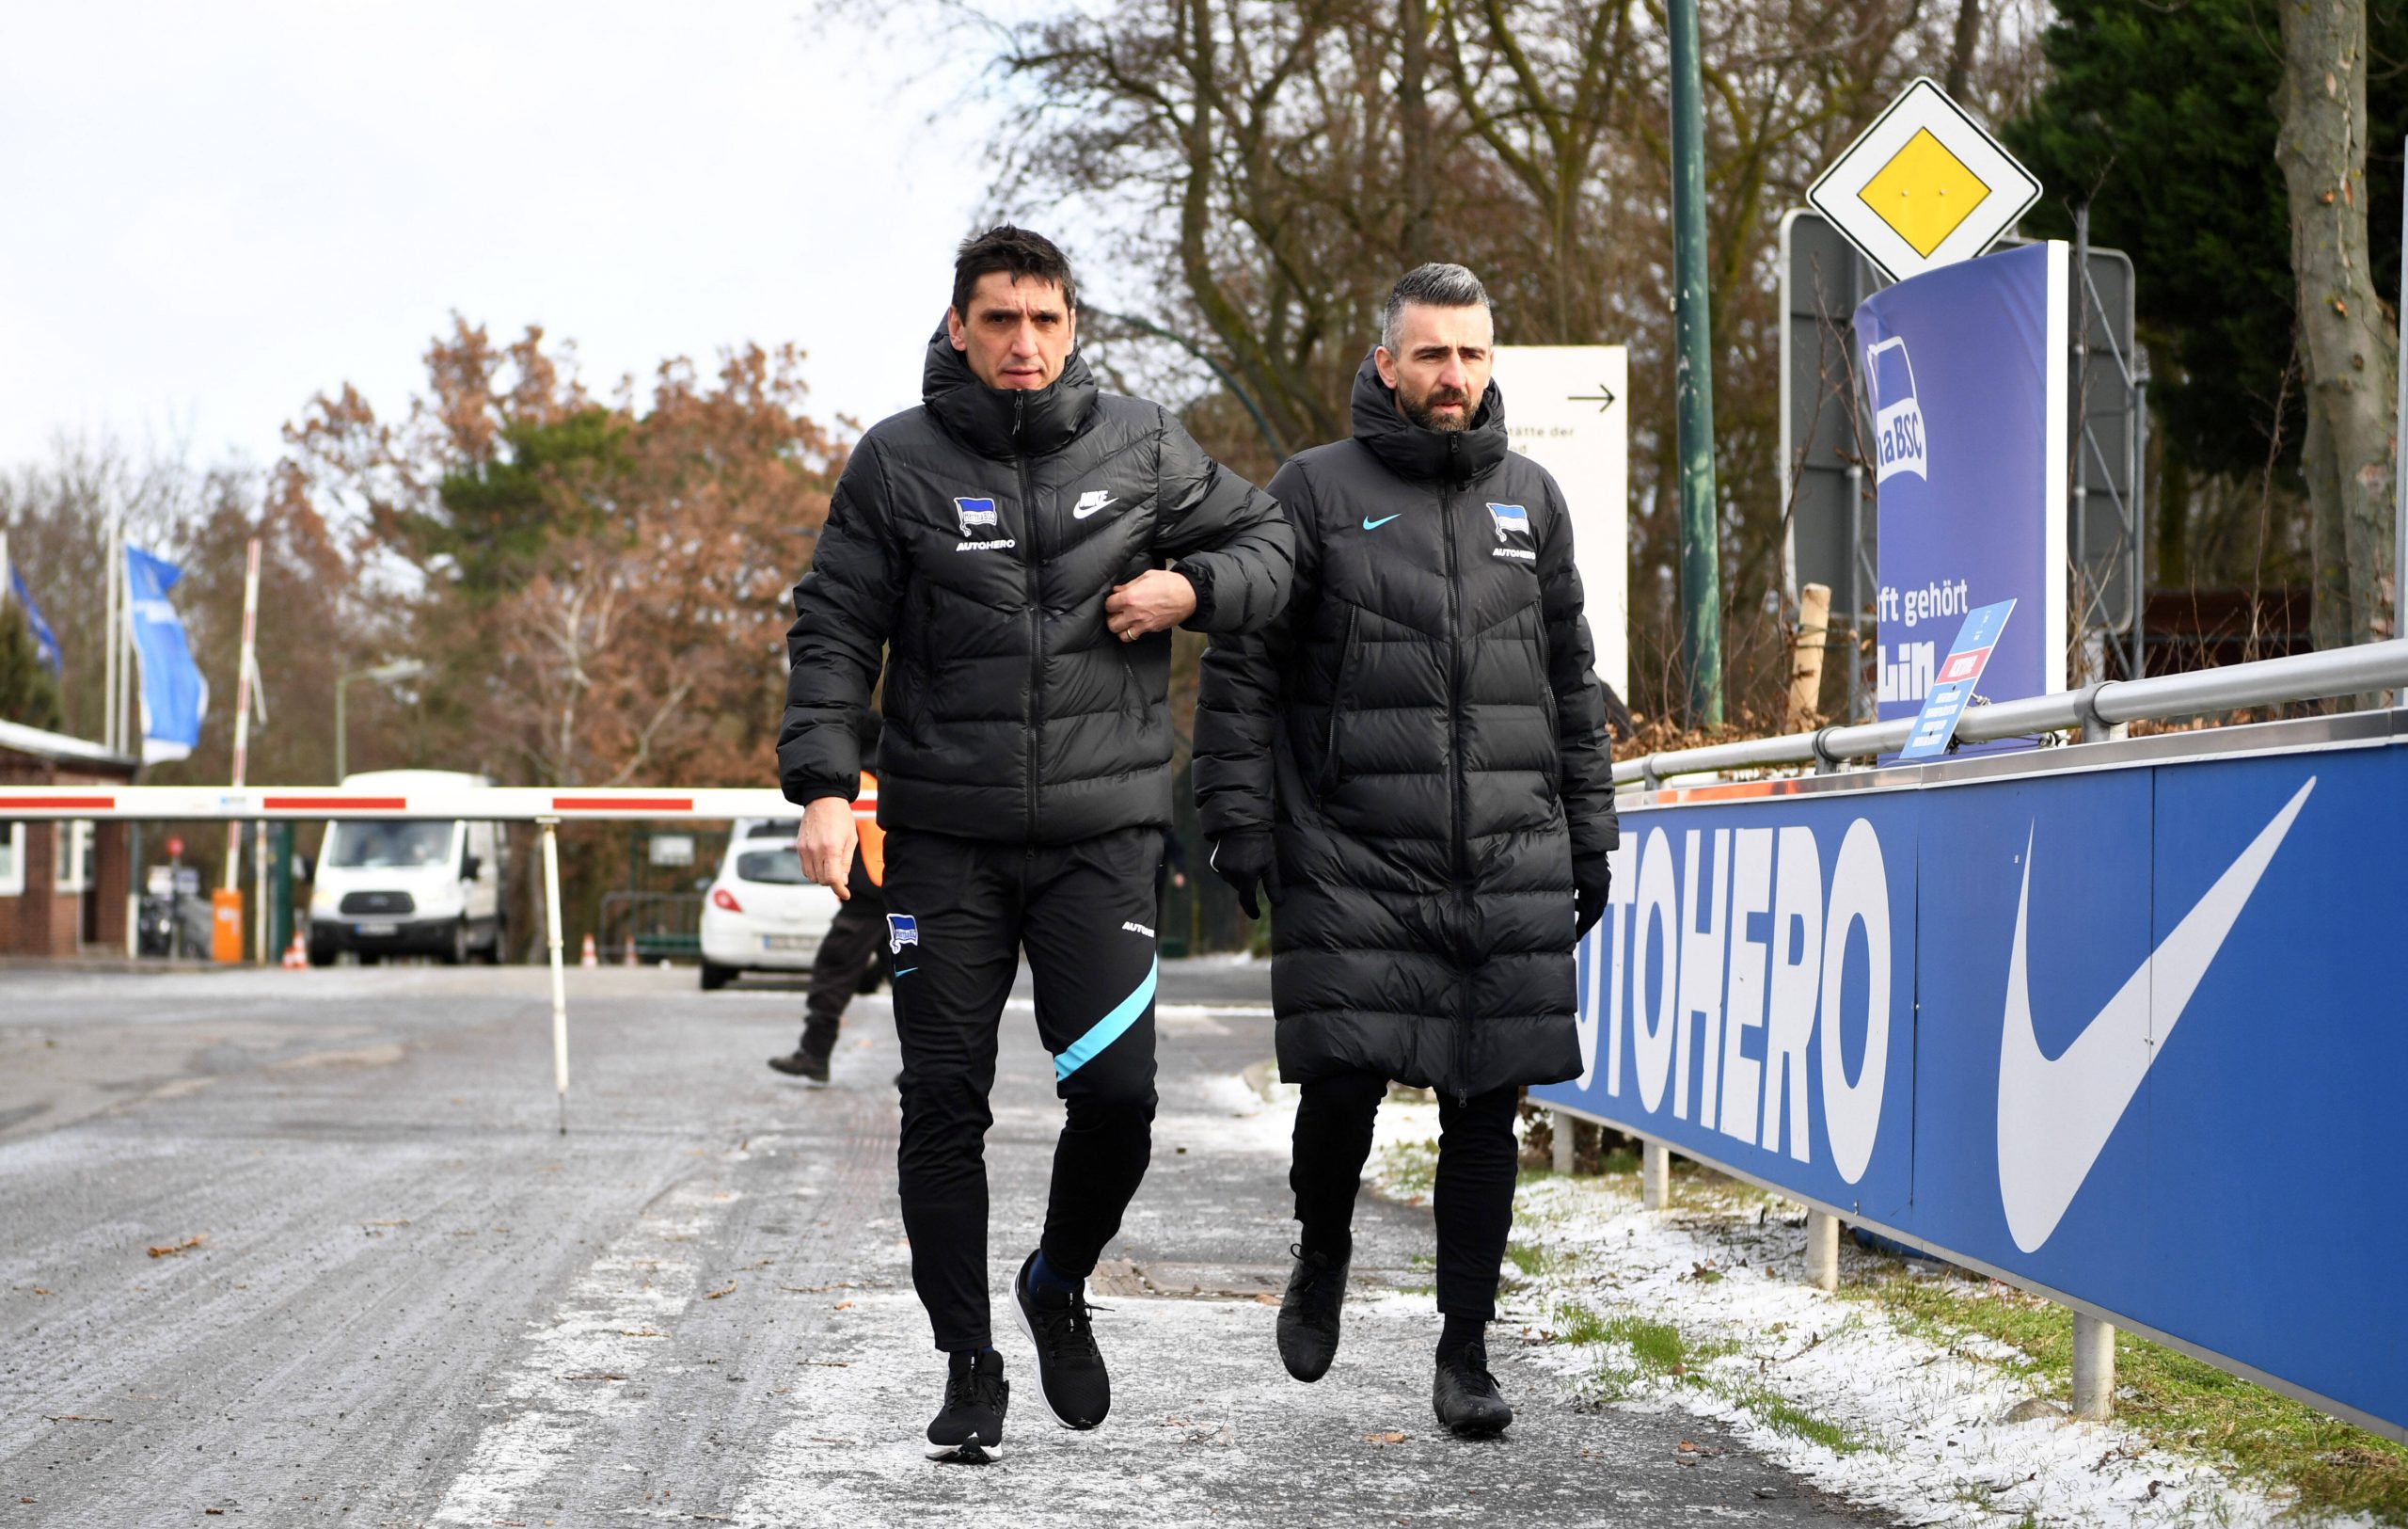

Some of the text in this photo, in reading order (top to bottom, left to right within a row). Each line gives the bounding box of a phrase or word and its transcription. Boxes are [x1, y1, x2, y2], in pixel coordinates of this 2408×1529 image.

[1550, 426, 1574, 438] der
[1079, 489, 1109, 507] NIKE
[956, 539, 1015, 551] AUTOHERO
[1877, 586, 1899, 623] ft
[1905, 579, 1968, 627] gehört
